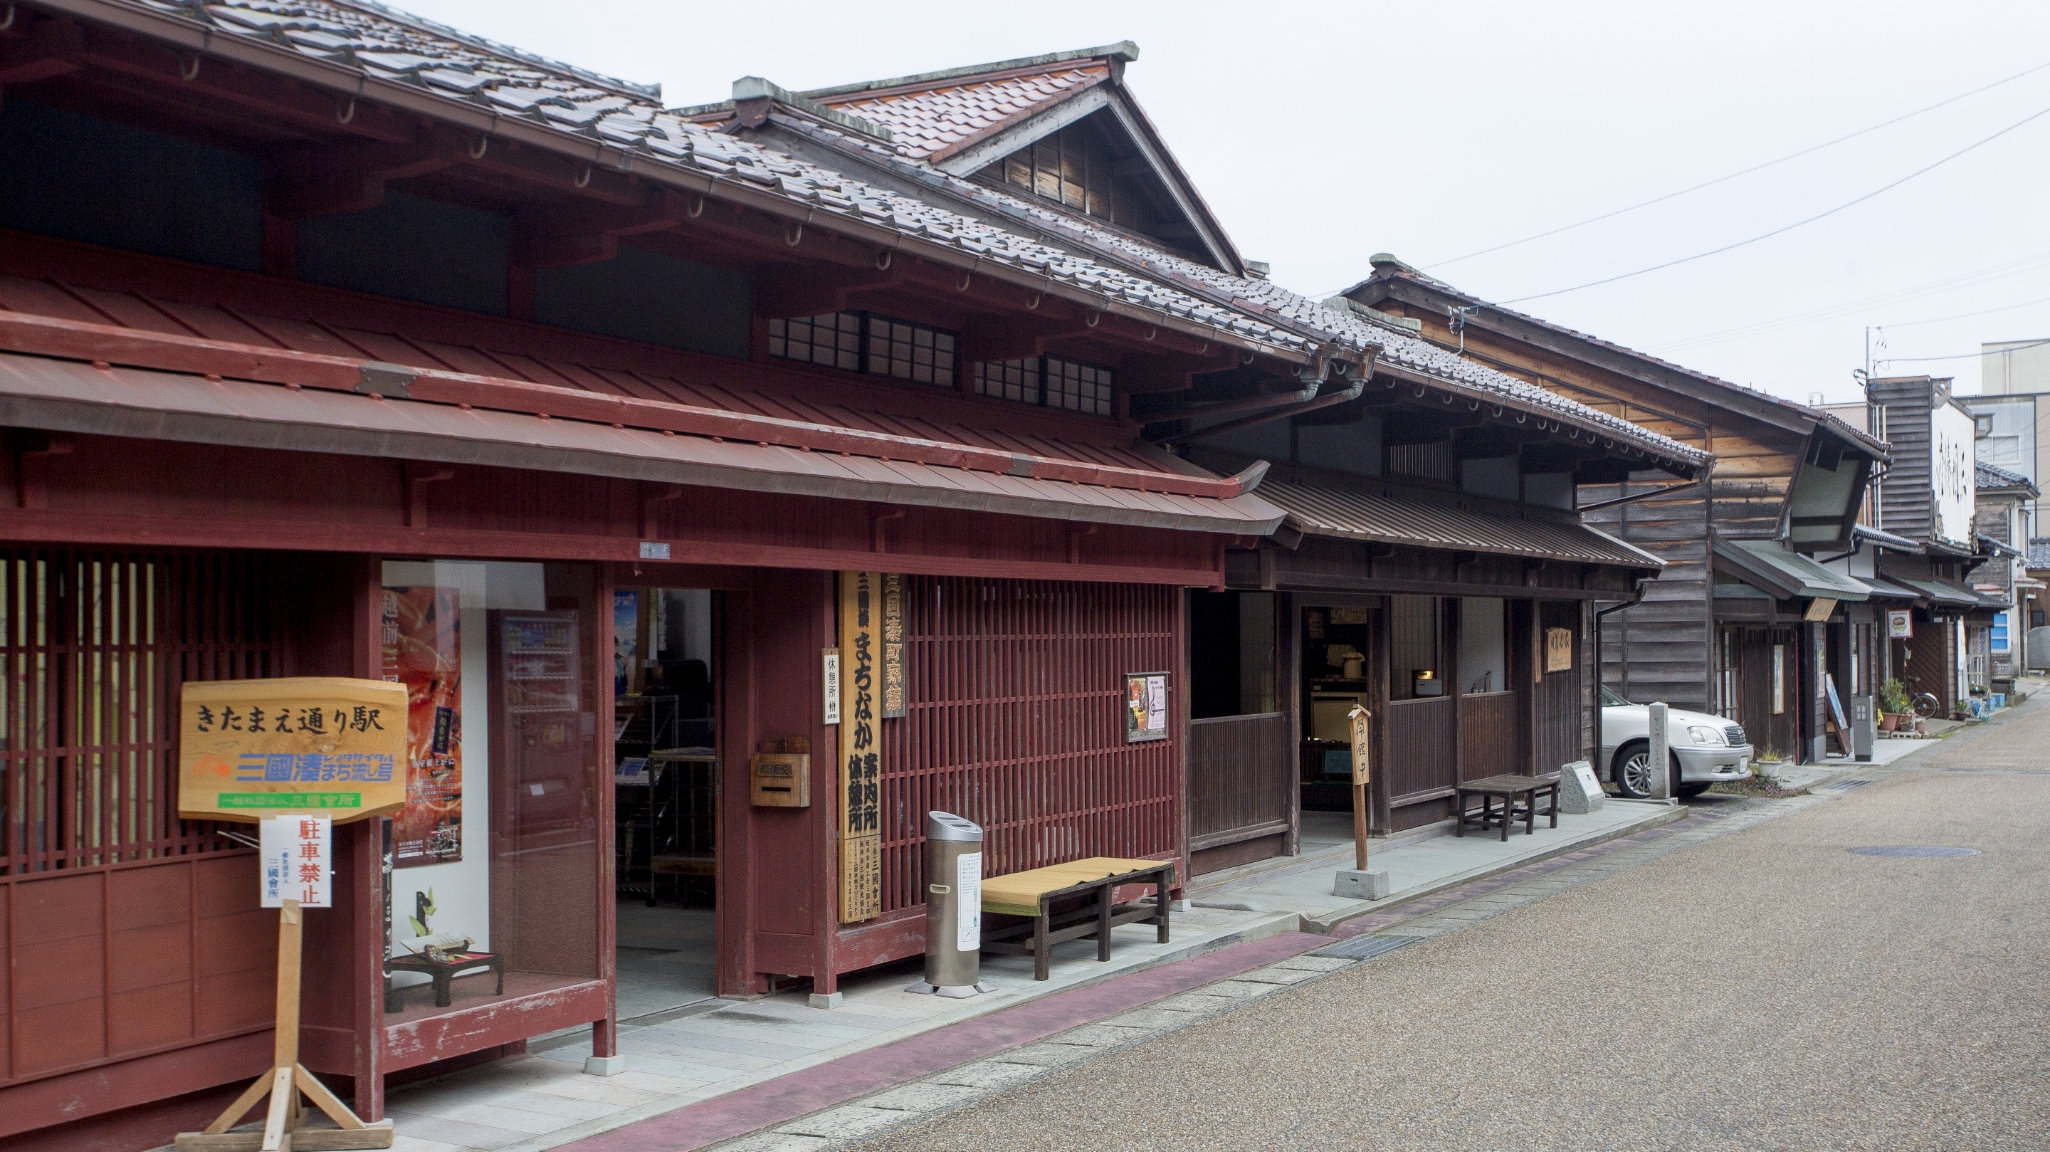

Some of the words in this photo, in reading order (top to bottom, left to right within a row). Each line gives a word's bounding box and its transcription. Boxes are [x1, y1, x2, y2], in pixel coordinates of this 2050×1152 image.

[828, 658, 836, 698] 休憩所
[854, 631, 873, 749] まちなか
[197, 704, 386, 735] きたまえ通り駅
[235, 752, 322, 782] 三國湊
[321, 763, 394, 782] まち流し号
[1356, 718, 1366, 778] 開館中
[848, 753, 863, 833] 休憩所
[863, 752, 878, 831] 案内所
[267, 858, 279, 899] 三國會所
[298, 819, 322, 905] 駐車禁止
